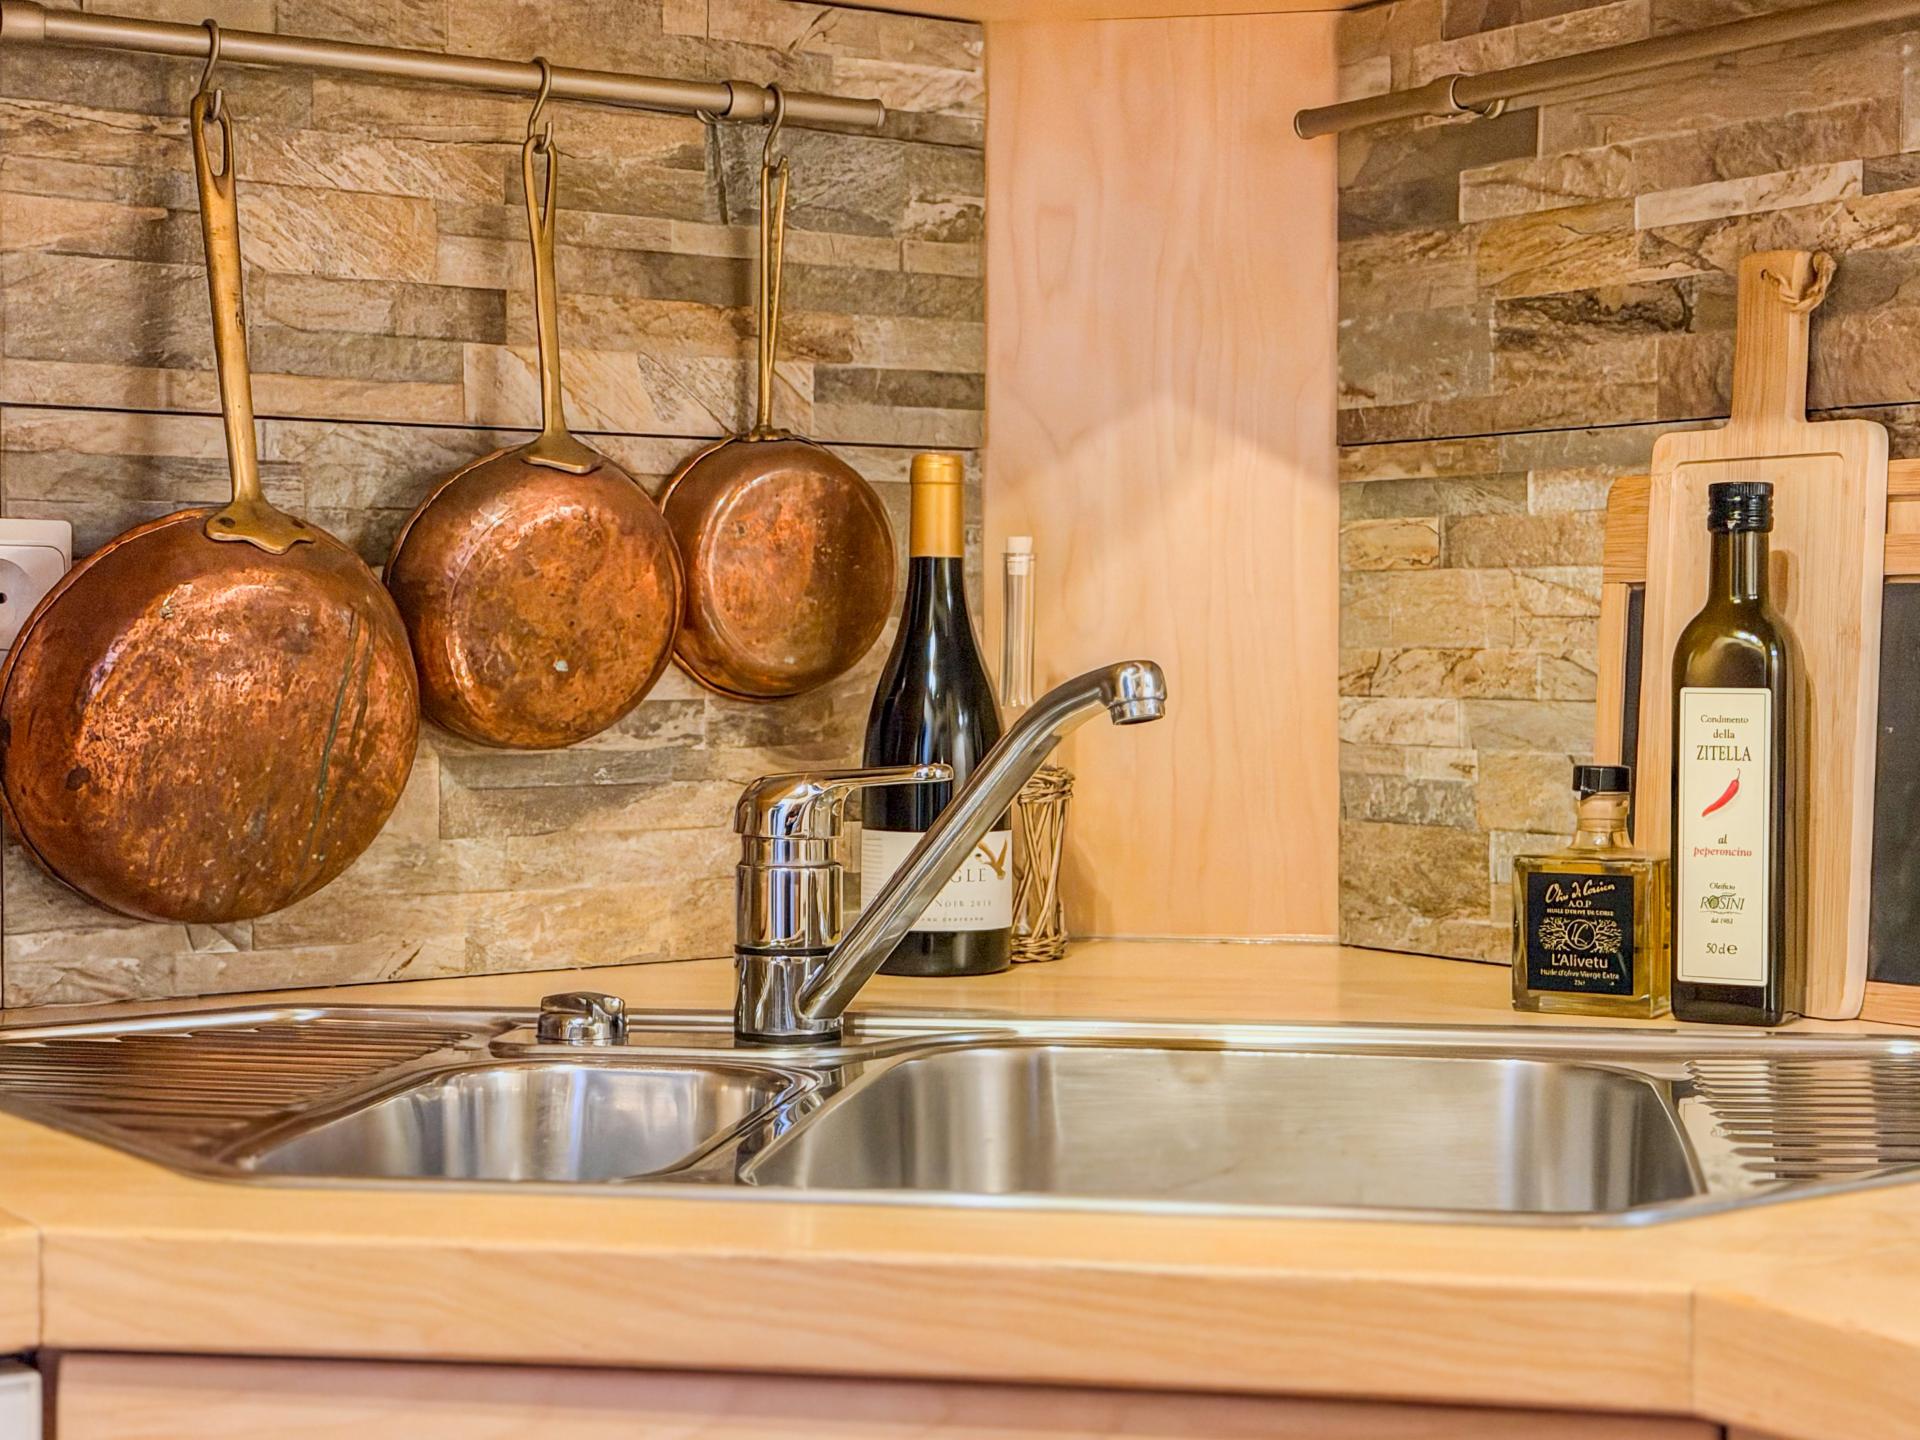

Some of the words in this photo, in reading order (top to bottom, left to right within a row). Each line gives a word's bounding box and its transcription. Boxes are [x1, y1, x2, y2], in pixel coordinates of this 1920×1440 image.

[1712, 728, 1735, 739] della
[1696, 744, 1752, 762] ZITELLA
[1717, 833, 1728, 845] al
[1693, 846, 1753, 858] peperoncino
[949, 867, 988, 883] GLE
[1700, 895, 1744, 910] ROSINI
[1705, 942, 1718, 955] 50
[1551, 953, 1609, 969] L'Alivetu
[1579, 970, 1601, 979] Vierge
[1602, 971, 1620, 979] Extra
